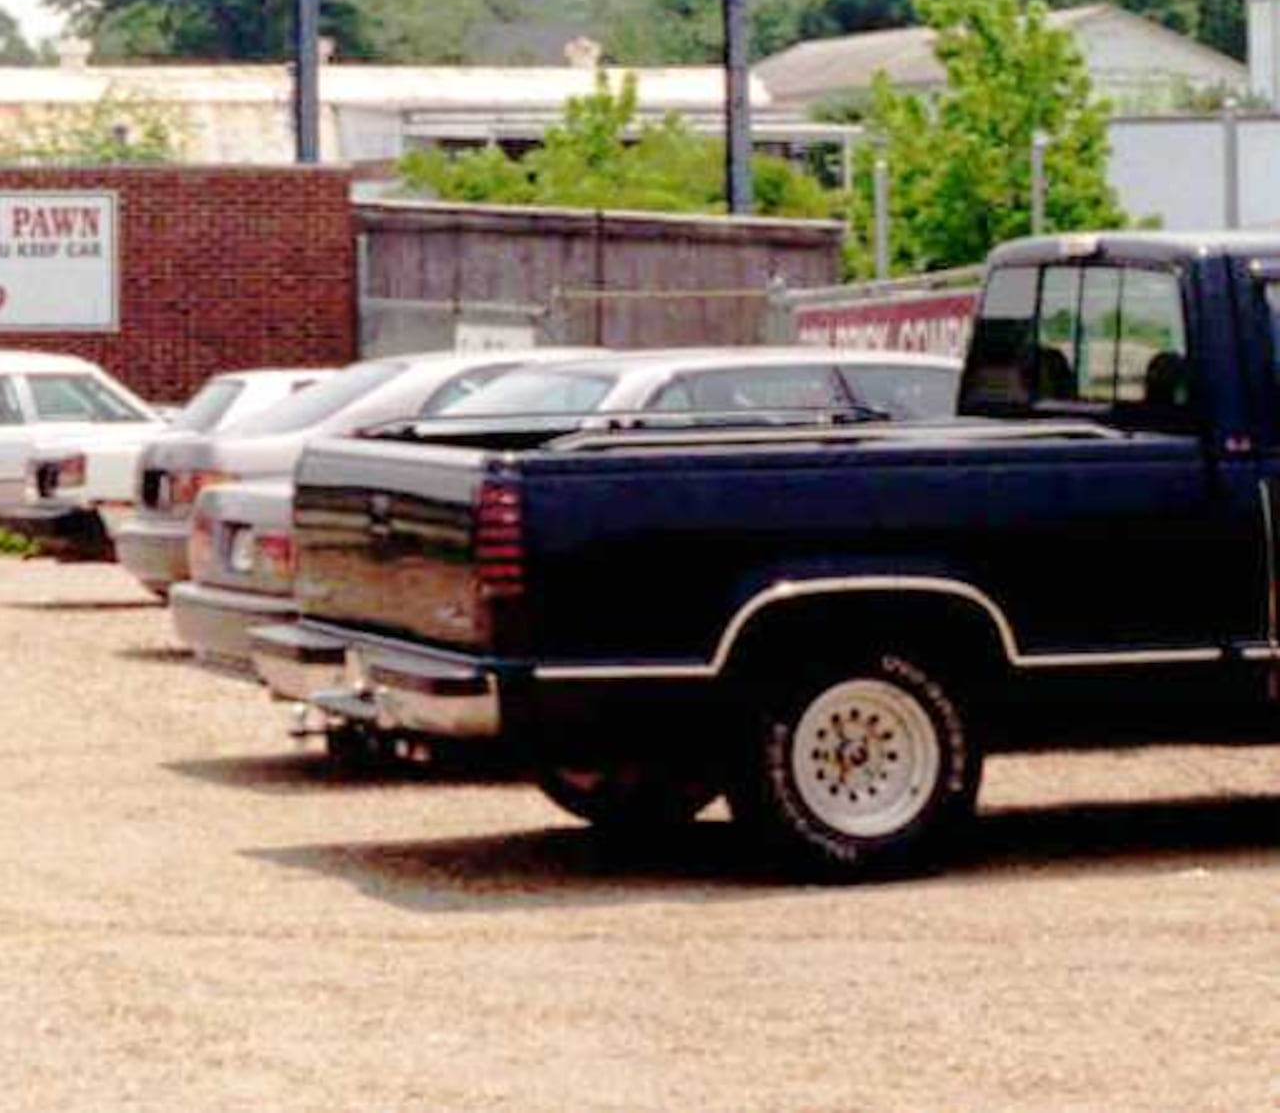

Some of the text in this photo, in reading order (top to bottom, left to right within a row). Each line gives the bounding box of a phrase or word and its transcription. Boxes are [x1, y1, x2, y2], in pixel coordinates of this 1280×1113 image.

[12, 206, 102, 238] PAWN
[17, 242, 60, 258] KEEP
[66, 242, 103, 258] CAR
